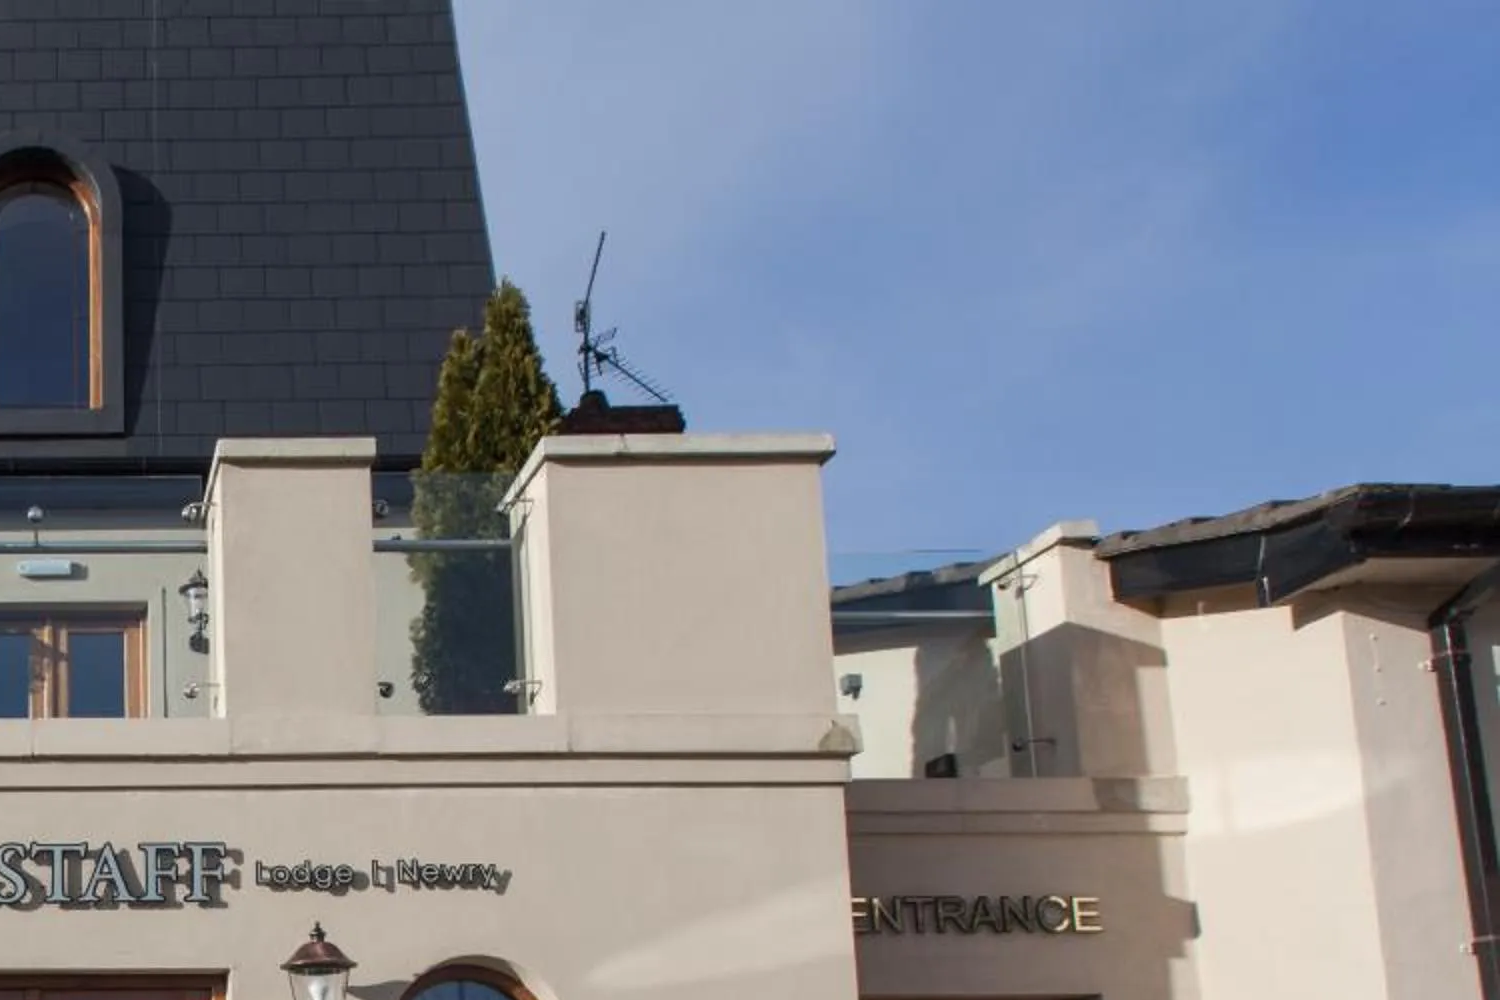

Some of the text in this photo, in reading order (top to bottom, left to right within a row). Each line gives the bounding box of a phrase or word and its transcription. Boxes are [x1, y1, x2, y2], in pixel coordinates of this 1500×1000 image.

[255, 859, 354, 888] Lodge
[396, 857, 498, 887] Newry
[851, 896, 1103, 933] ENTRANCE
